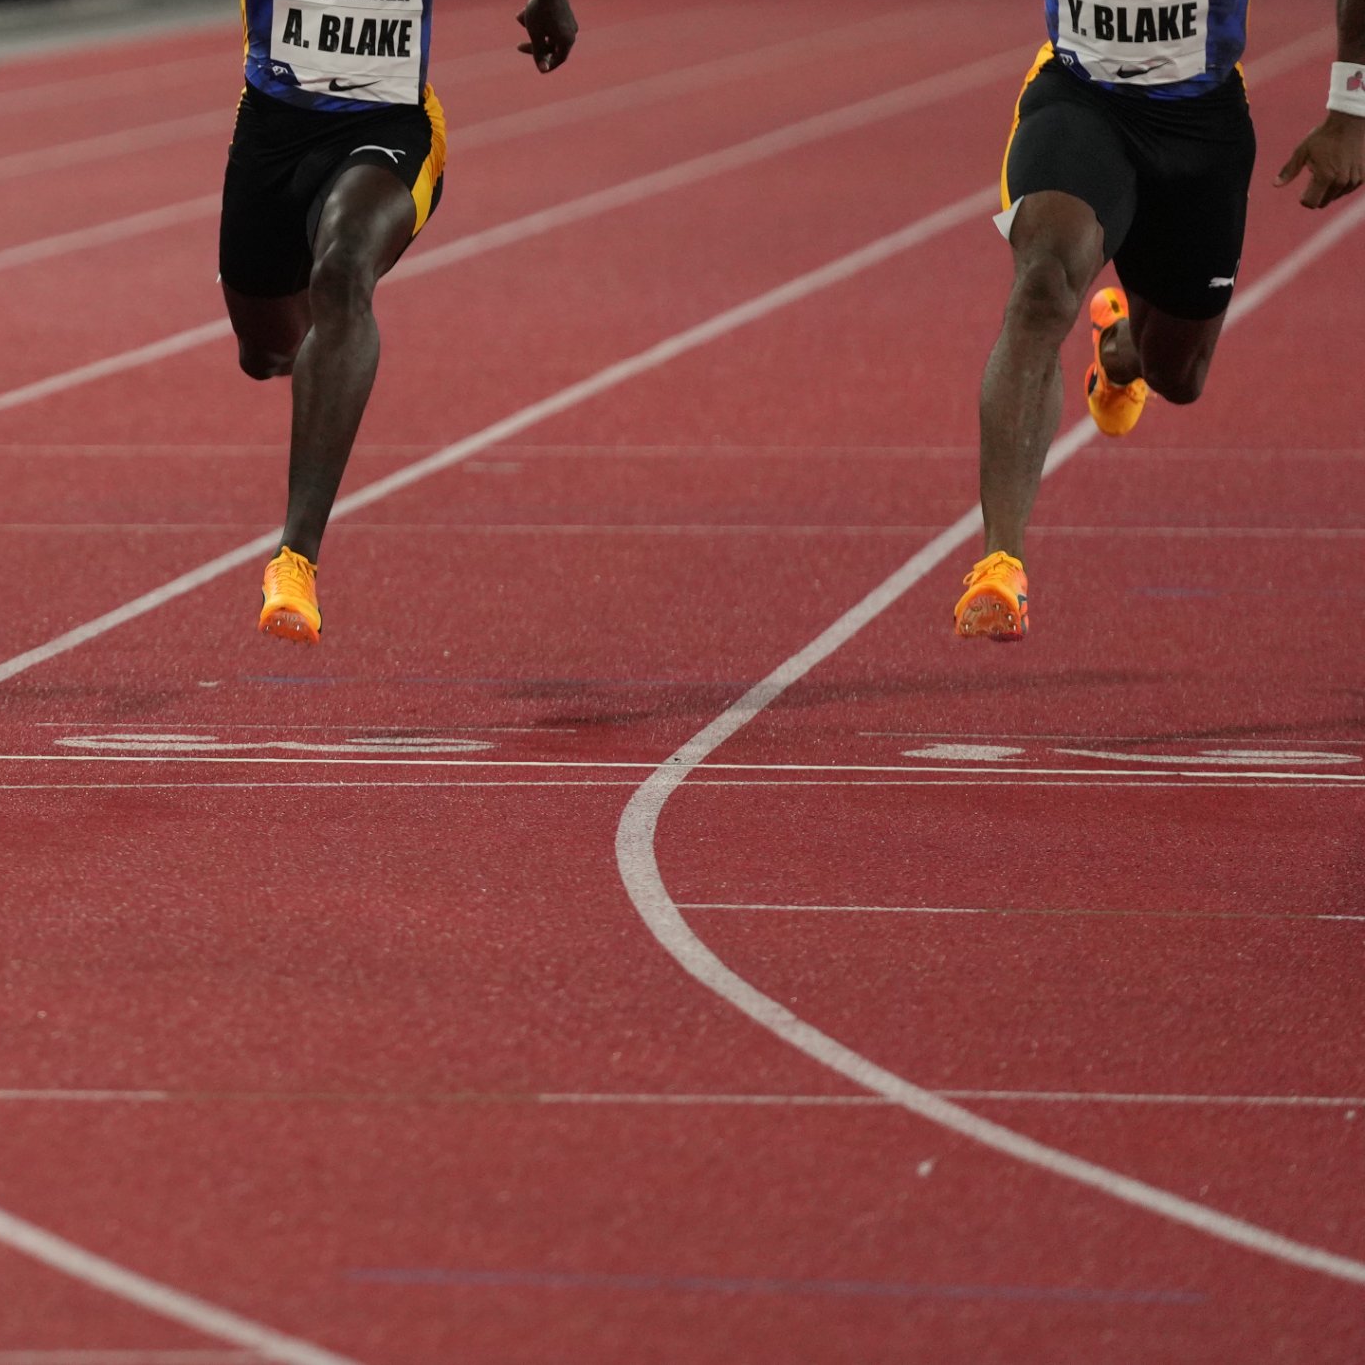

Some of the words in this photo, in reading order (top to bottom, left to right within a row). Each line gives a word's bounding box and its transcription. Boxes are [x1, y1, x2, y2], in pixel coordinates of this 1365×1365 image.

[282, 8, 309, 48] A.
[317, 13, 413, 58] BLAKE
[1094, 1, 1198, 43] BLAKE
